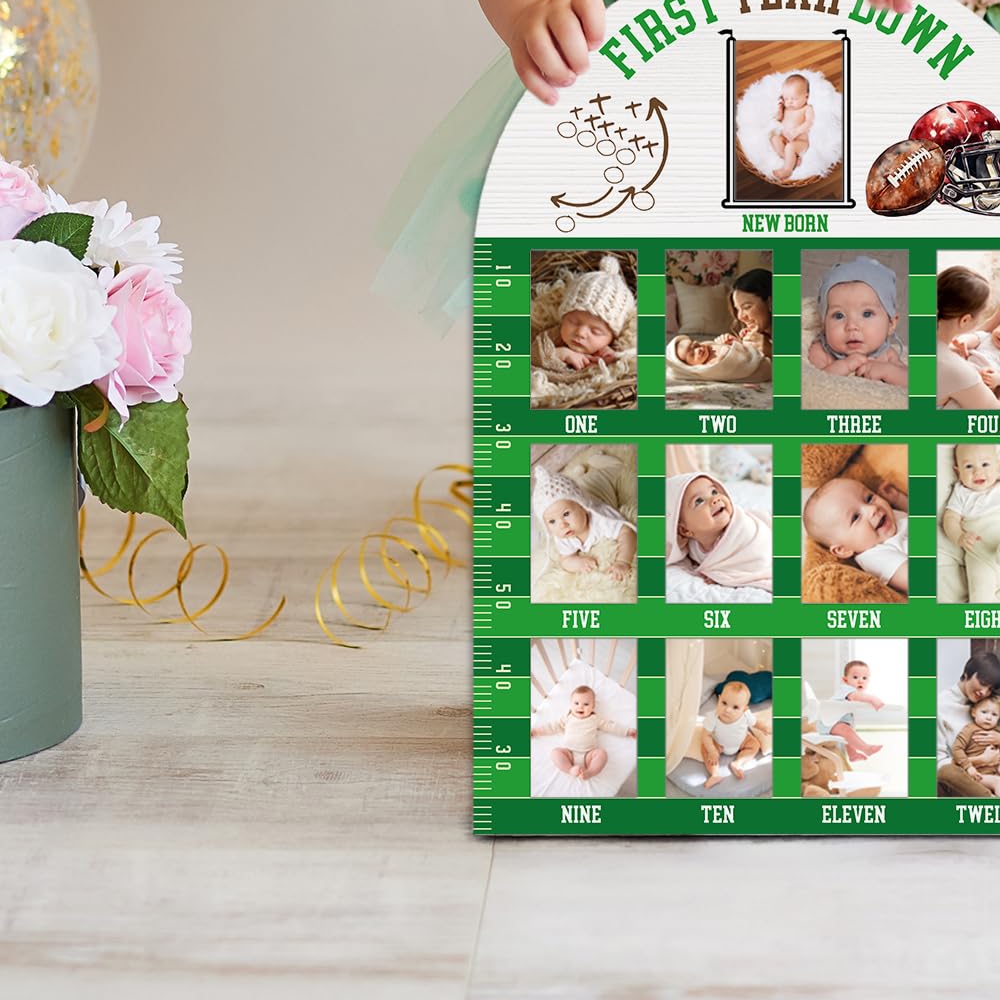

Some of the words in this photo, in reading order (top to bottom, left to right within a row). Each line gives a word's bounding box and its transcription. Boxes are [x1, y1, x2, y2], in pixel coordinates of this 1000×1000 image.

[742, 213, 781, 233] NEW
[783, 213, 829, 233] BORN
[565, 415, 598, 434] ONE
[698, 415, 737, 434] TWO
[826, 415, 882, 434] THREE
[562, 610, 600, 629] FIVE
[703, 610, 731, 629] SIX
[827, 610, 881, 629] SEVEN
[560, 805, 602, 824] NINE
[700, 805, 735, 824] TEN
[821, 805, 886, 824] ELEVEN
